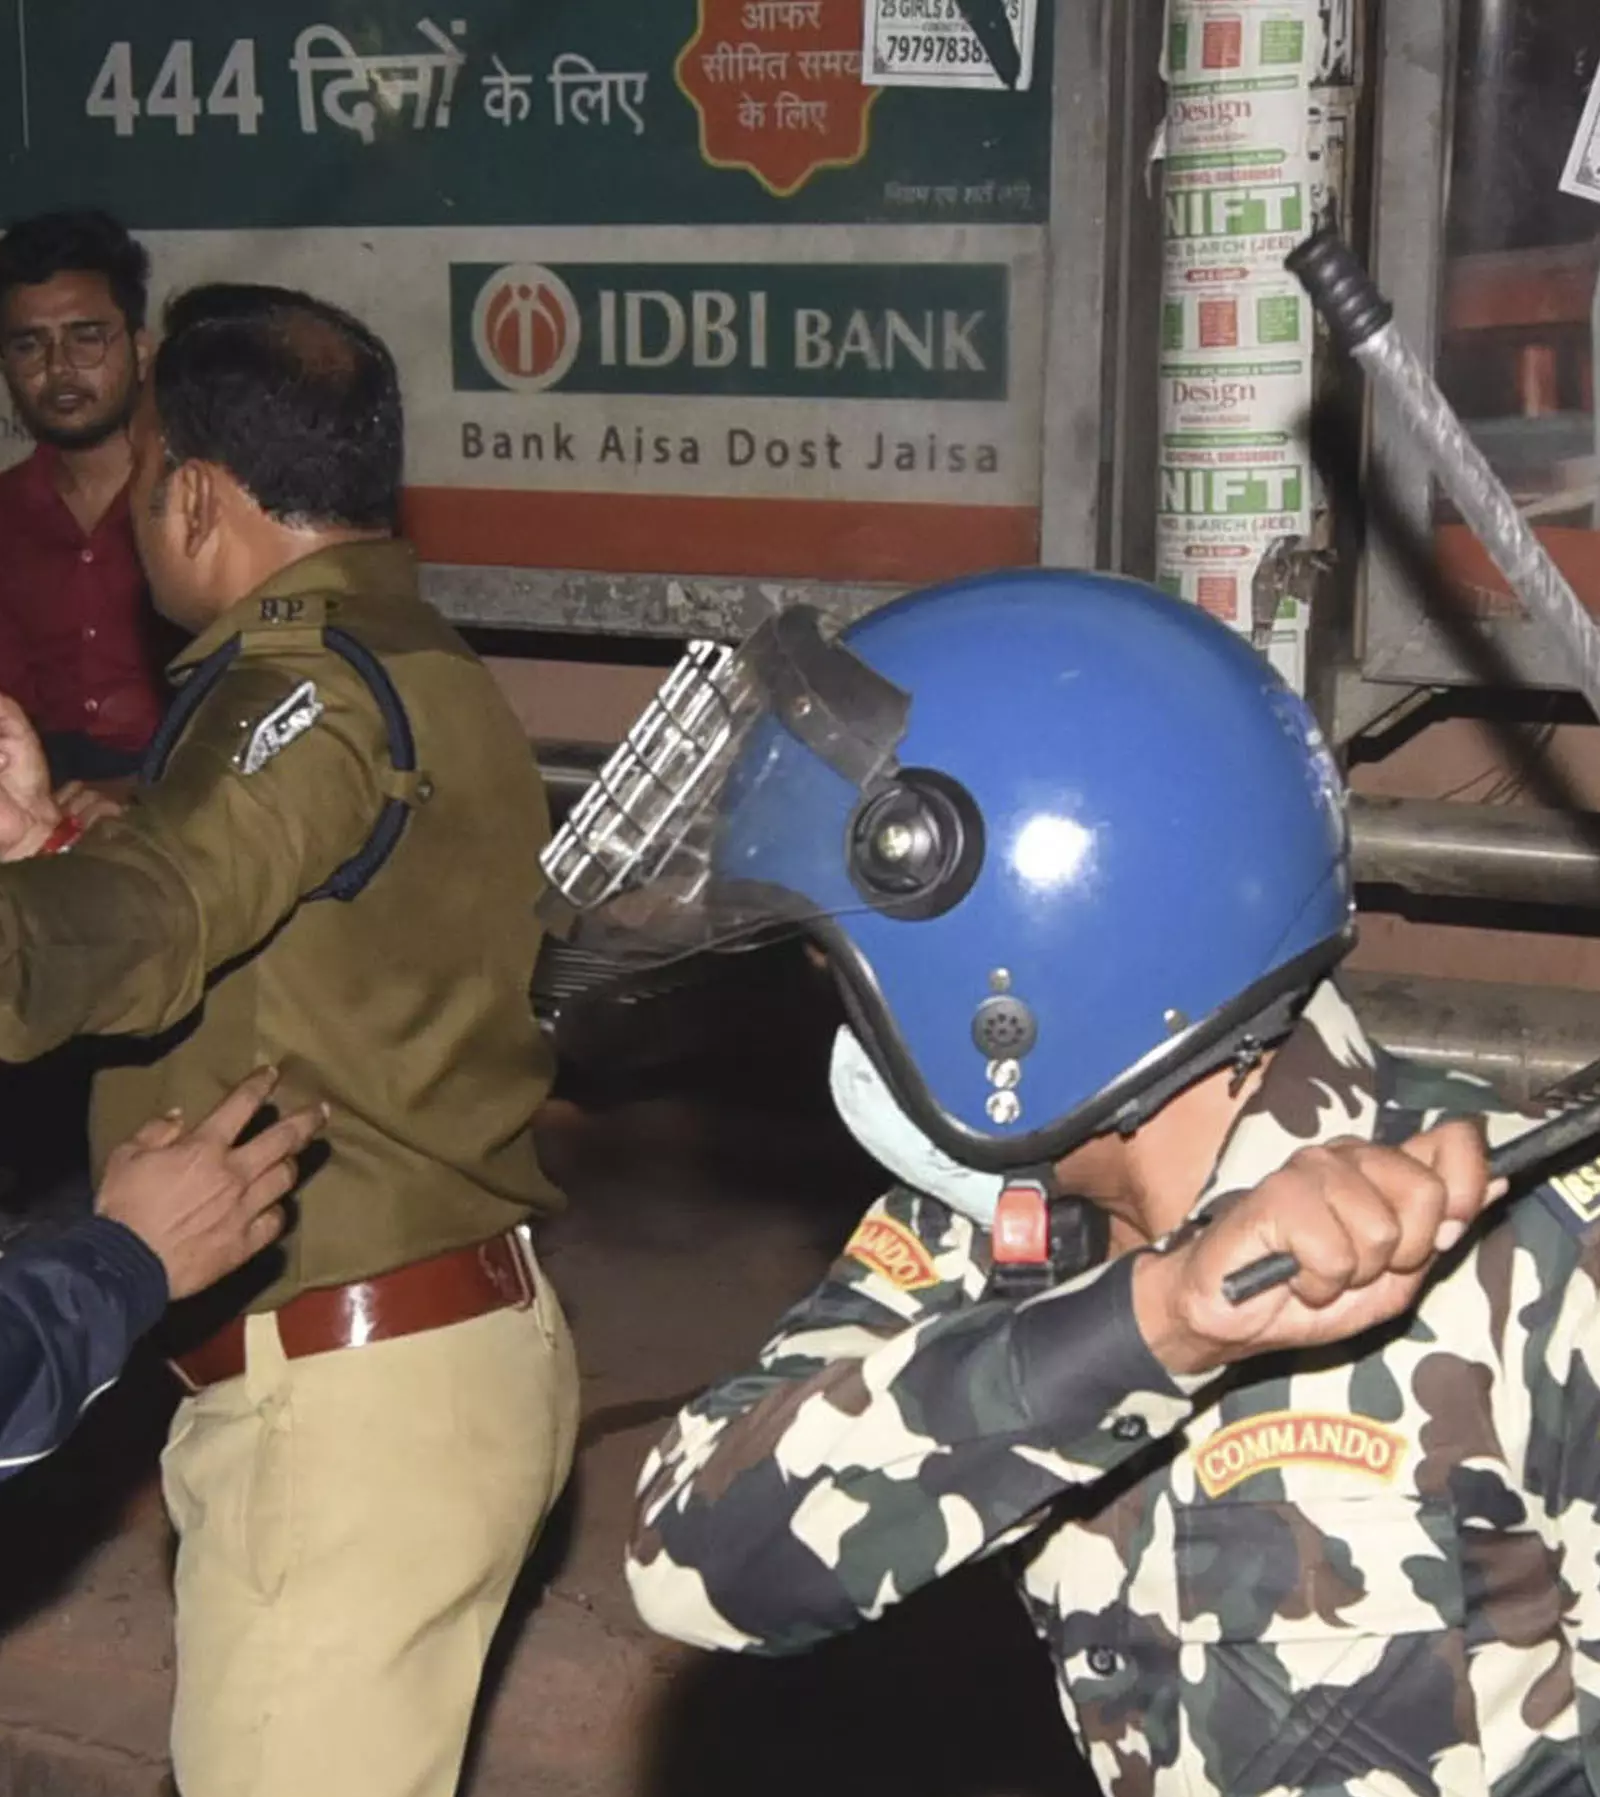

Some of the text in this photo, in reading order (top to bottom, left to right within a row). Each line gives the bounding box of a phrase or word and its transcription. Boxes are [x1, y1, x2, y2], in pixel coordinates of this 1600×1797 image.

[86, 18, 648, 144] 444 दिनों के लिए
[702, 41, 790, 82] सीमित
[739, 91, 828, 135] के लिए
[599, 289, 987, 372] IDBI BANK
[1172, 380, 1256, 407] Design
[461, 421, 998, 474] Bank Aisa Dost Jaisa
[1160, 468, 1298, 514] NIFT
[1201, 1422, 1391, 1481] COMMANDO
